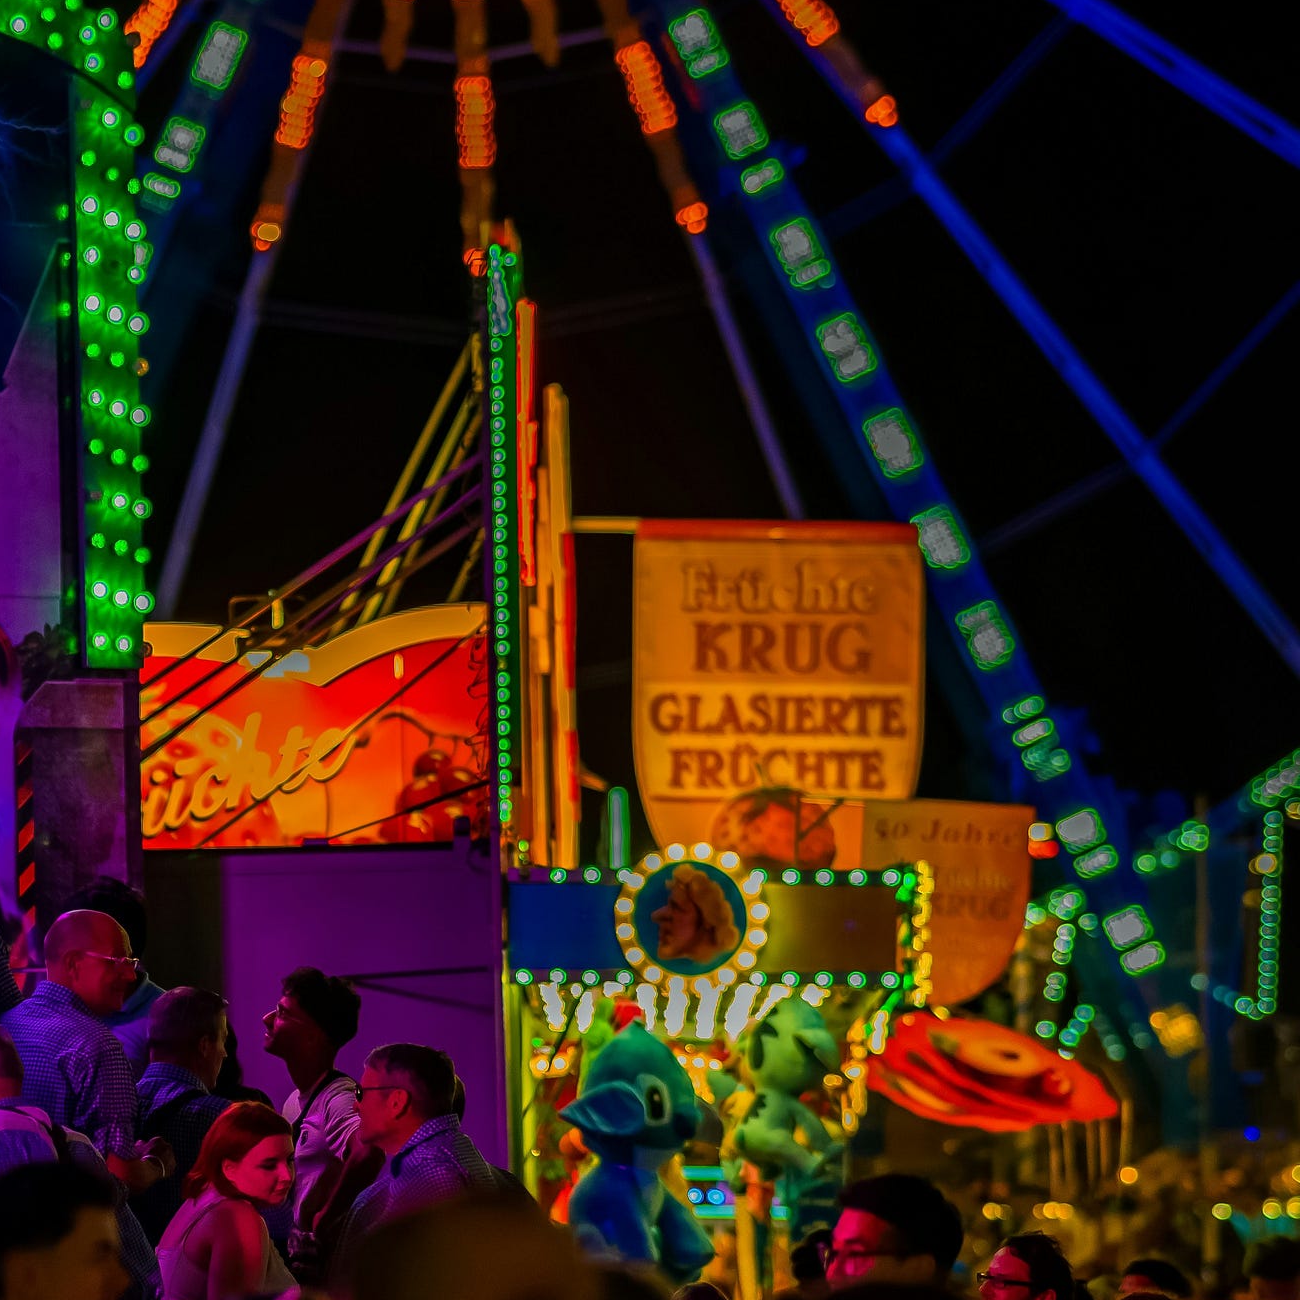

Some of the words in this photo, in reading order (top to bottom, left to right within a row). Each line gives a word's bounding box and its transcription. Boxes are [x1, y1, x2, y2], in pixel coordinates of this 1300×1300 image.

[693, 620, 873, 676] KRUG
[650, 692, 908, 738] GLASIERTE
[668, 741, 887, 791] FRÜCHTE
